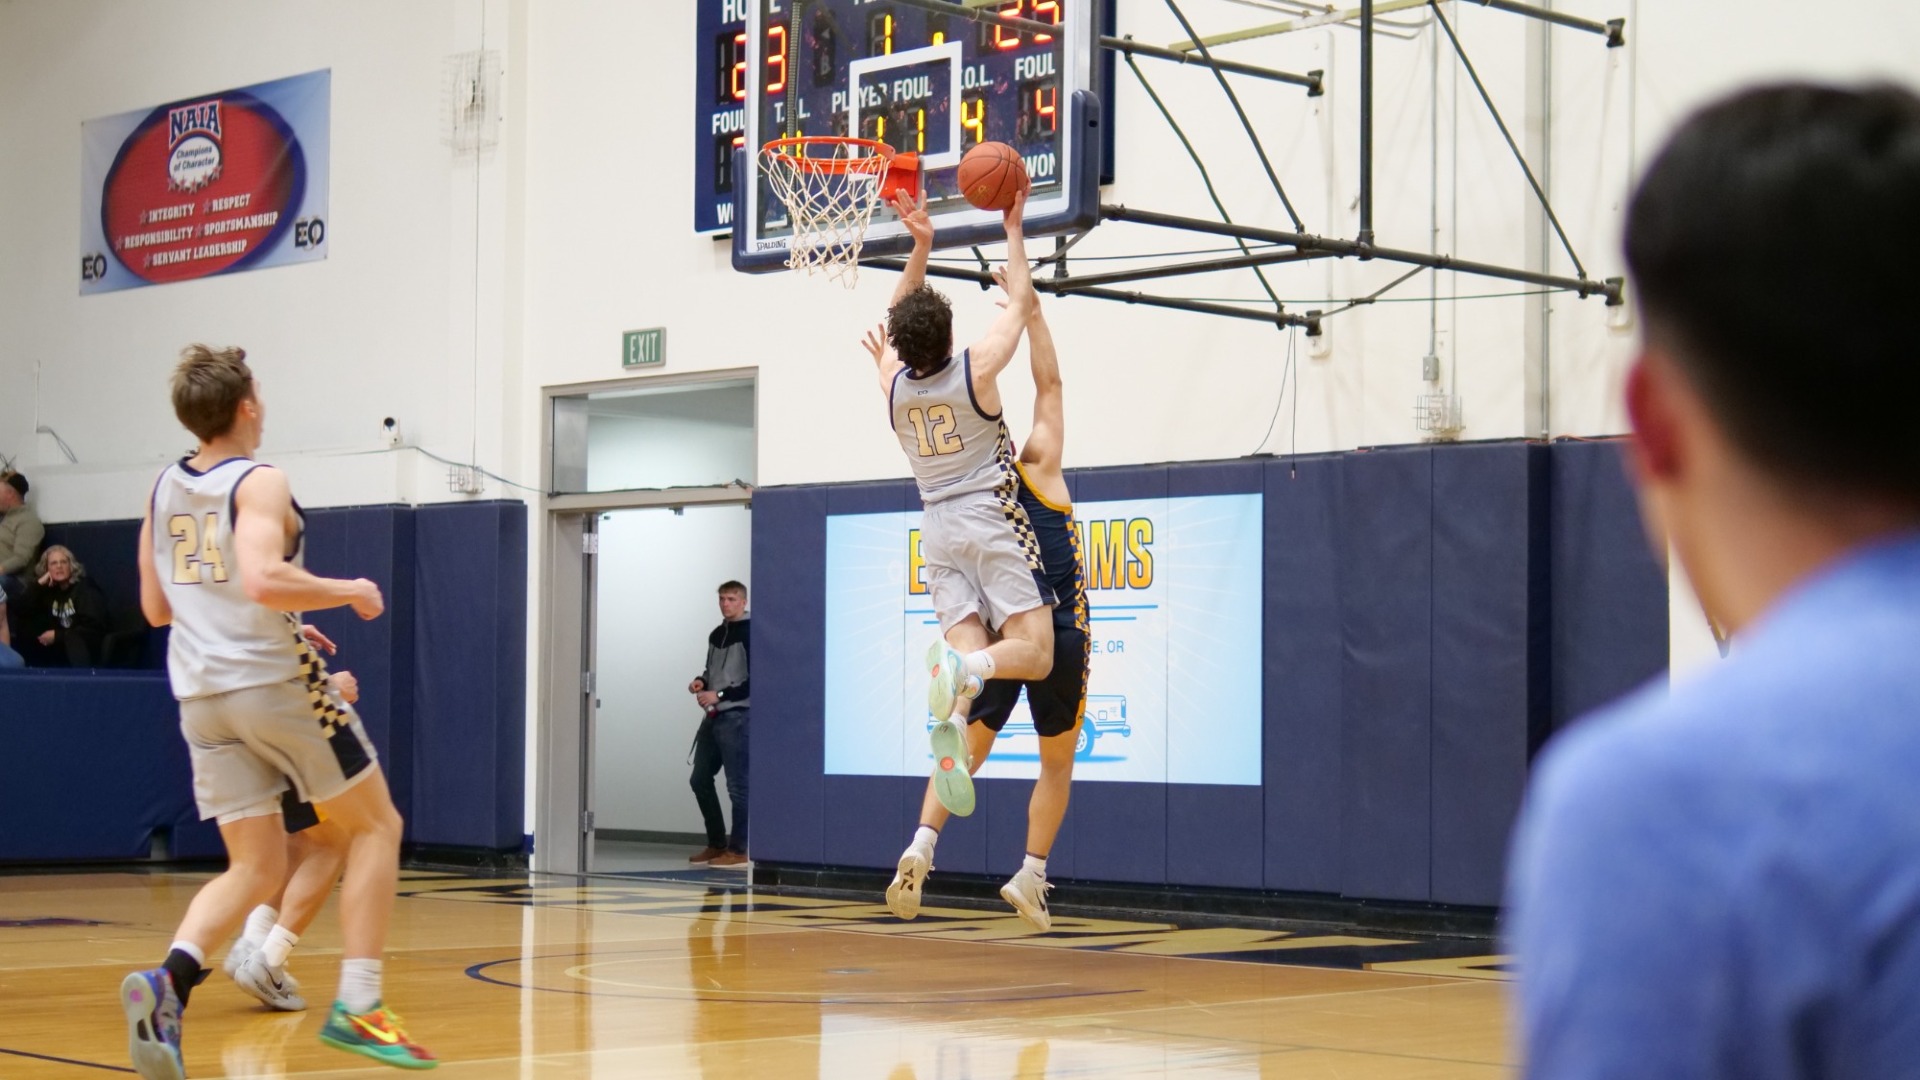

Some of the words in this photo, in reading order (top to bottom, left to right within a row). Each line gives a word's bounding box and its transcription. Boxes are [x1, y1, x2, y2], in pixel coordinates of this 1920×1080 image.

[1015, 53, 1056, 81] FOUL
[894, 76, 933, 102] FOUL
[169, 101, 221, 149] NAIA
[960, 98, 984, 144] 4
[174, 162, 181, 172] of
[182, 156, 215, 170] Character
[177, 145, 213, 159] Champions
[149, 204, 195, 223] INTEGRITY
[212, 194, 251, 212] RESPECT
[125, 227, 193, 249] RESPONSIBILITY
[204, 211, 279, 236] SPORTSMANSHIP
[152, 249, 192, 267] SERVANT
[193, 239, 247, 260] LEADERSHIP
[756, 238, 787, 251] SPALDING
[630, 332, 657, 363] EXIT
[908, 403, 964, 457] 12
[168, 512, 229, 585] 24
[1107, 640, 1125, 653] OR
